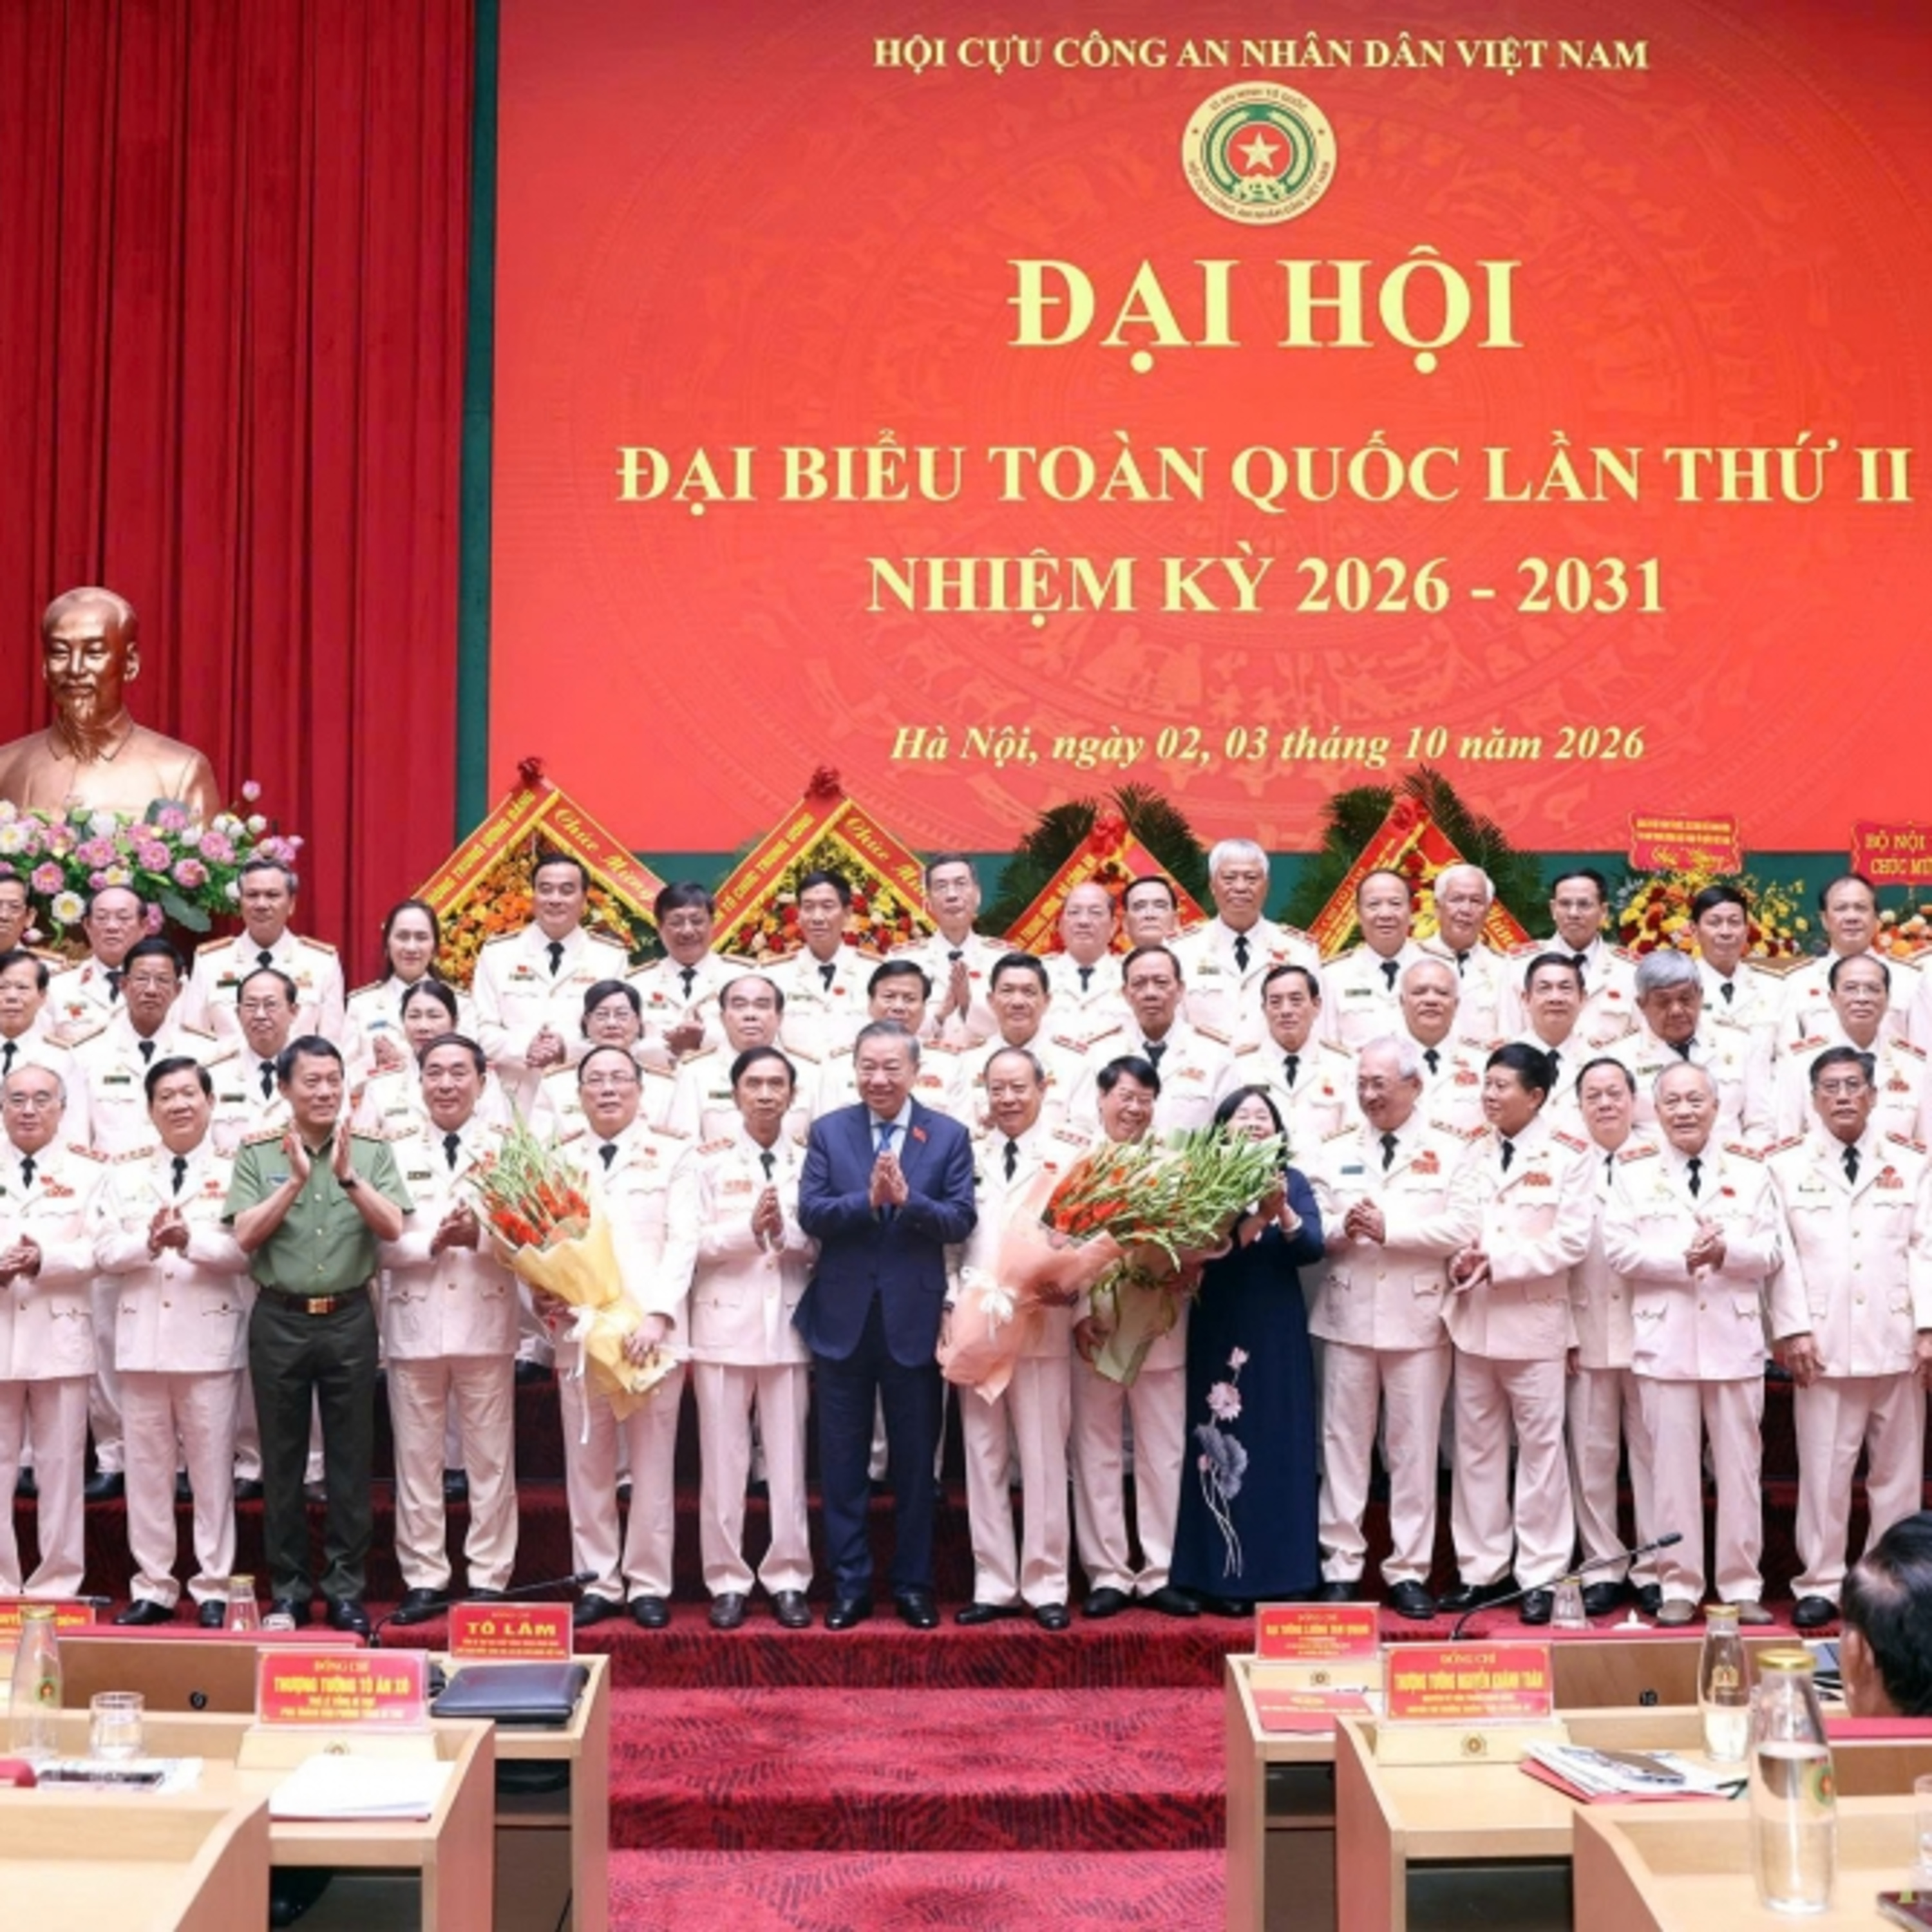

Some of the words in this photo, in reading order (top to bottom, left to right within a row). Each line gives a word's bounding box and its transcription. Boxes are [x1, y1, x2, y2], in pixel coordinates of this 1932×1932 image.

[873, 35, 945, 74] HỘI
[957, 35, 1042, 74] CỰU
[1054, 30, 1166, 68] CÔNG
[1177, 40, 1229, 68] AN
[1242, 31, 1352, 68] NHÂN
[1364, 31, 1444, 68] DÂN
[1455, 38, 1548, 76] VIỆT
[1558, 41, 1650, 69] NAM
[1007, 259, 1240, 374] ĐẠI
[1276, 244, 1522, 374] HỘI
[616, 446, 756, 516] ĐẠI
[778, 430, 965, 502] BIỂU
[988, 430, 1208, 502] TOÀN
[1231, 430, 1459, 514] QUỐC
[1482, 430, 1642, 502] LẦN
[1663, 431, 1839, 502] THỨ
[1856, 448, 1913, 502] II
[865, 547, 1137, 628] NHIỆM
[1160, 540, 1274, 612] KỲ
[1296, 557, 1450, 613] 2026
[1471, 589, 1495, 598] -
[1517, 557, 1665, 613] 2031
[889, 726, 949, 761] Hà
[960, 726, 1038, 767] Nội,
[1052, 726, 1144, 768] ngày
[1156, 726, 1211, 766] 02,
[1225, 726, 1269, 761] 03
[1280, 726, 1390, 768] tháng
[1404, 726, 1448, 760] 10
[1459, 728, 1542, 761] năm
[1554, 726, 1645, 761] 2026
[1864, 829, 1889, 852] BỘ
[1894, 829, 1926, 854] NỘI
[466, 1619, 495, 1635] TÔ
[504, 1620, 557, 1637] LÂM
